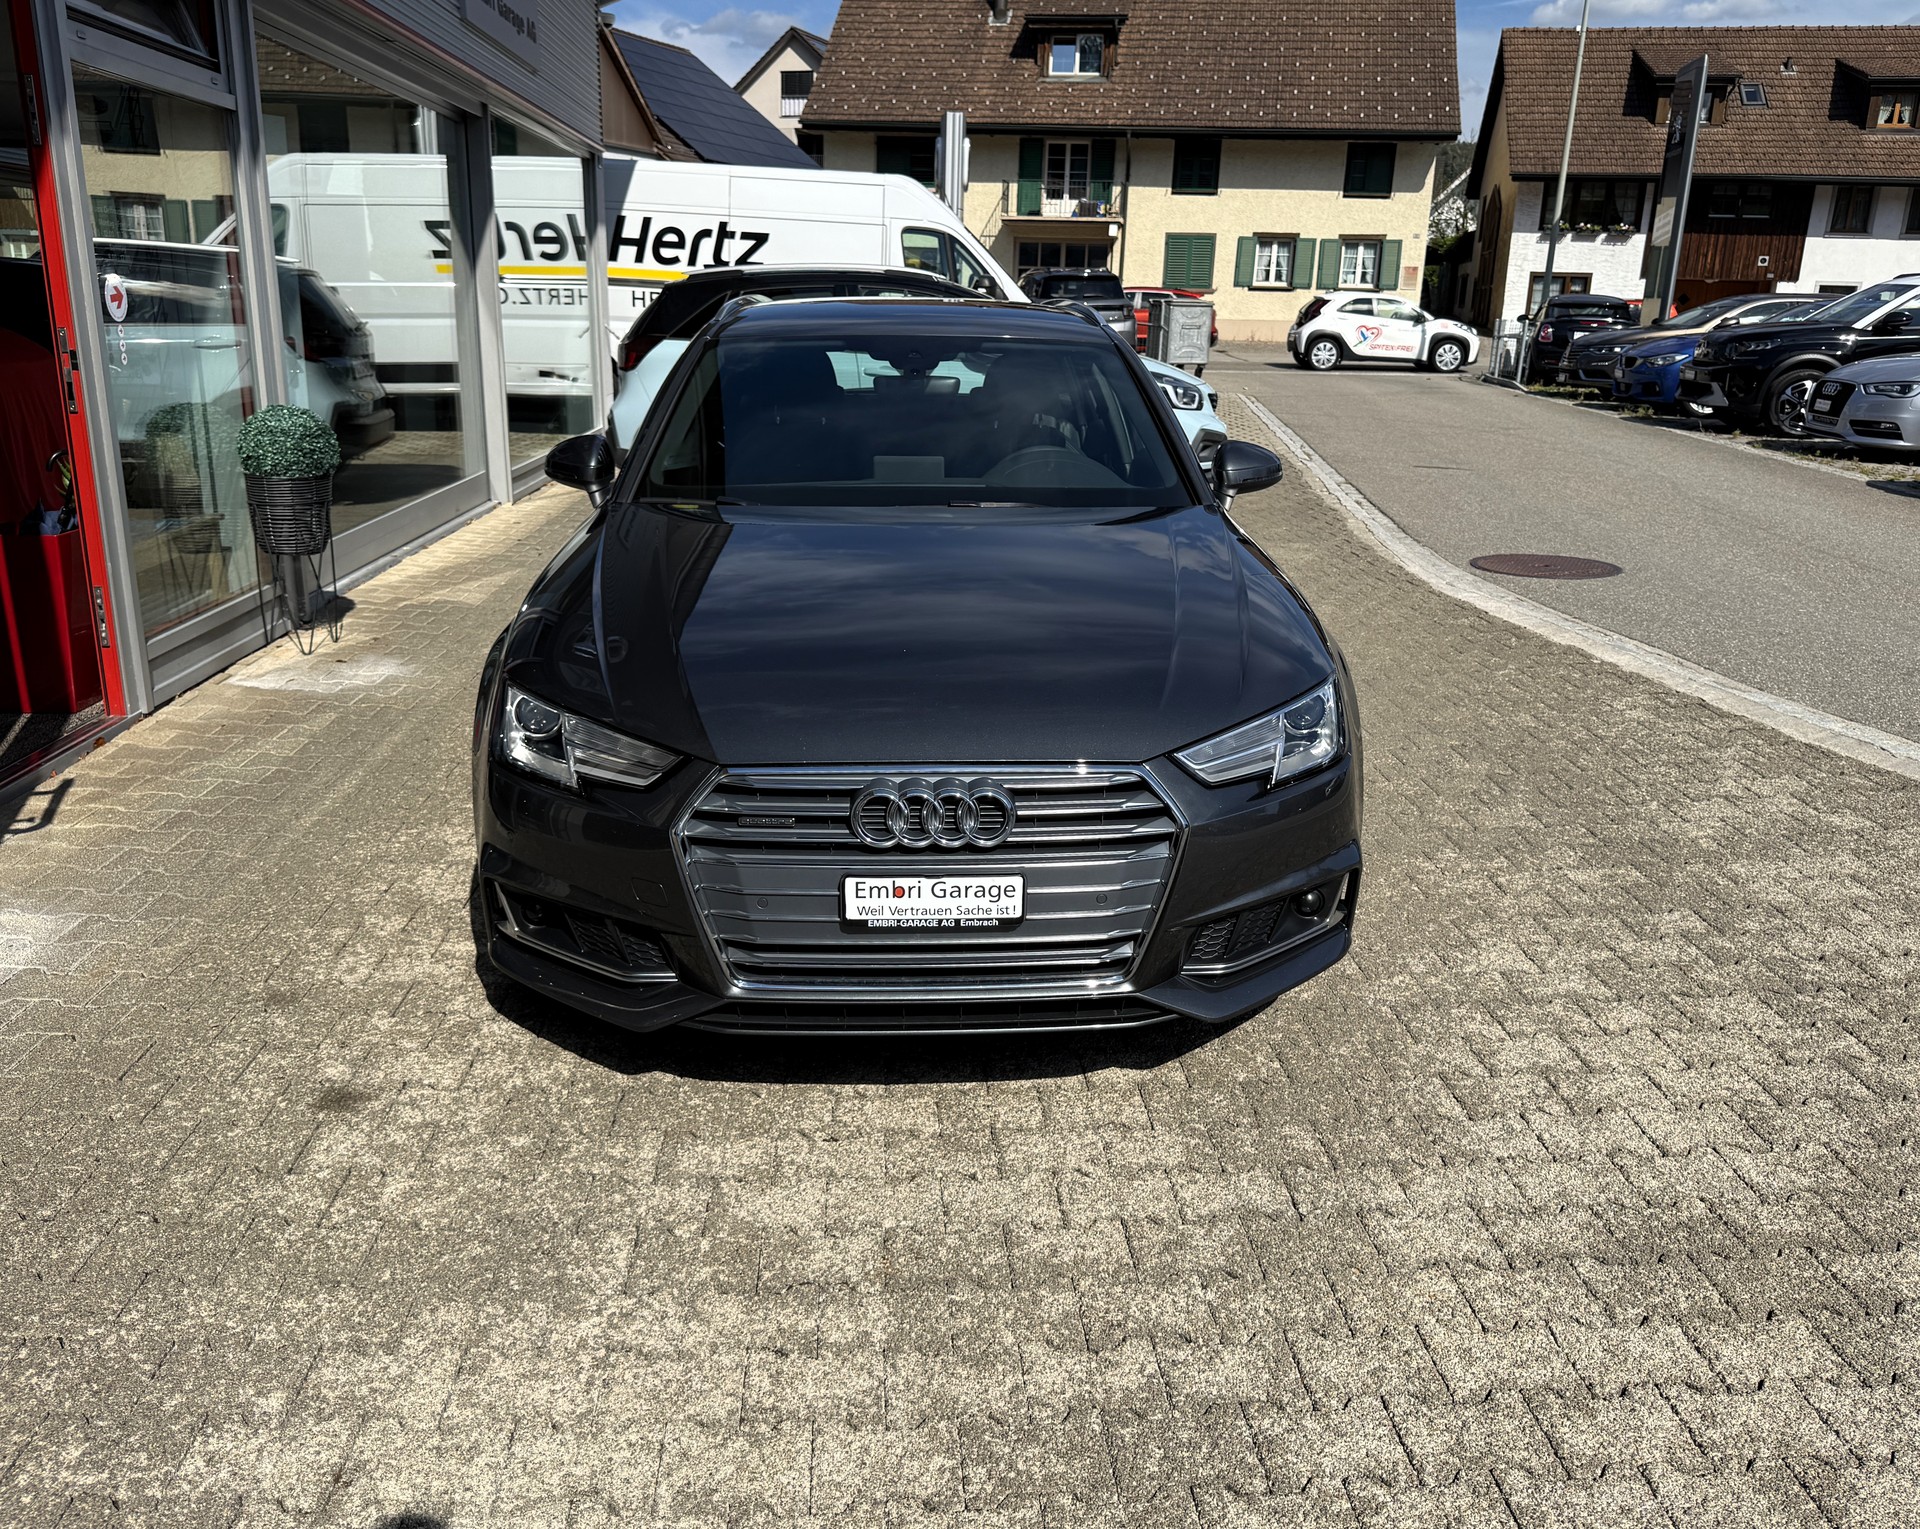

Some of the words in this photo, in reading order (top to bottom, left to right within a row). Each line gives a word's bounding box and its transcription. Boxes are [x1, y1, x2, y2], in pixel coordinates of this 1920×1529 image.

[608, 214, 770, 267] Hertz
[855, 880, 922, 899] Embri
[931, 881, 1016, 903] Garage
[857, 905, 884, 916] Weil
[889, 906, 952, 916] Vertrauen
[956, 905, 992, 916] Sache
[868, 919, 938, 927] EMBRI-GARAGE
[941, 919, 955, 927] AG
